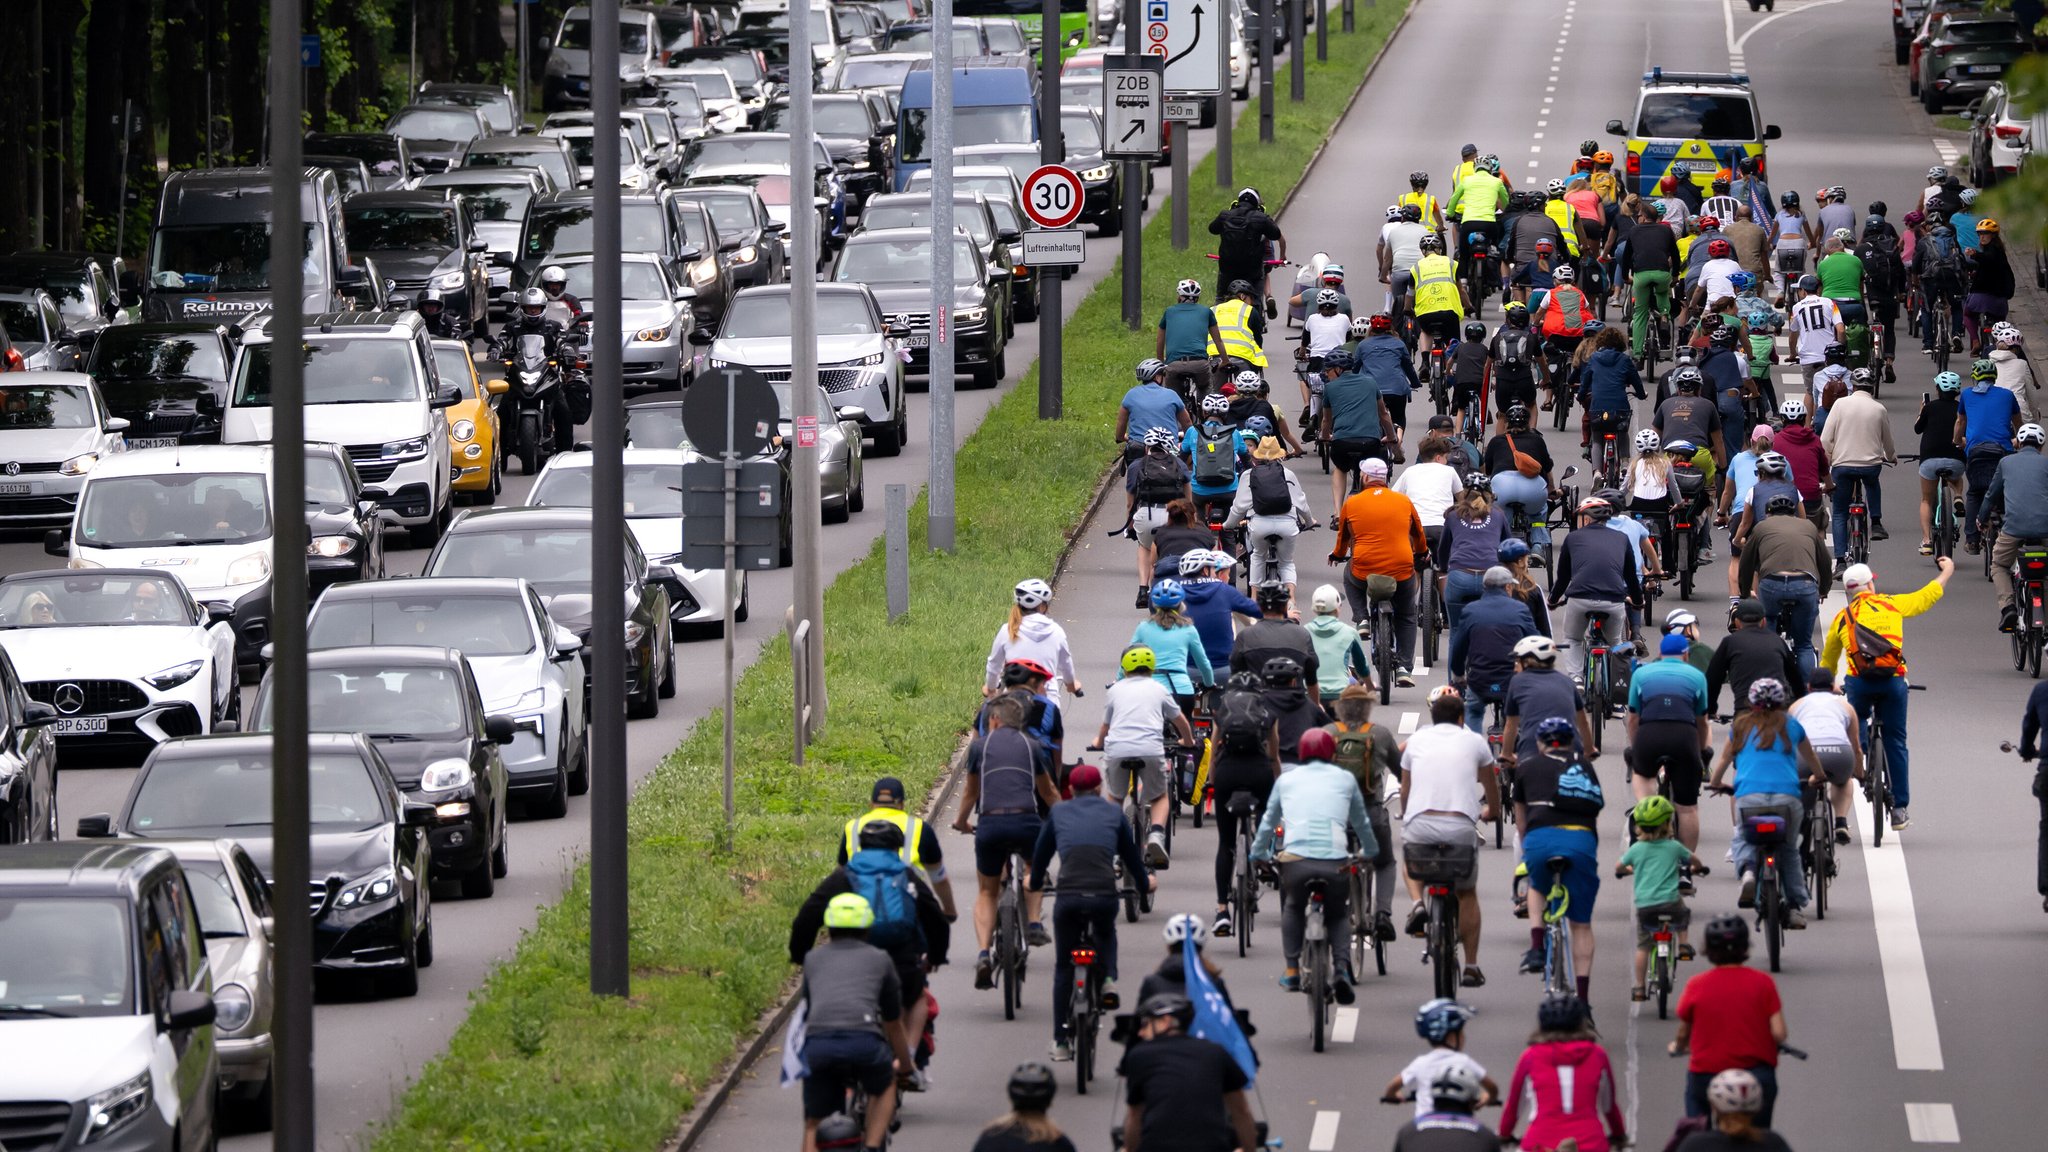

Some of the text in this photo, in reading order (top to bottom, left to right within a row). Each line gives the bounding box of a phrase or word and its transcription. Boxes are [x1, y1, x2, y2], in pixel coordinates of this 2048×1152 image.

[1116, 76, 1149, 90] ZOB
[1166, 106, 1193, 116] 150 m
[1035, 183, 1070, 210] 30
[1027, 243, 1081, 253] Luftreinhaltung
[1798, 304, 1826, 331] 10
[906, 336, 928, 346] 2673
[75, 718, 106, 731] 6300
